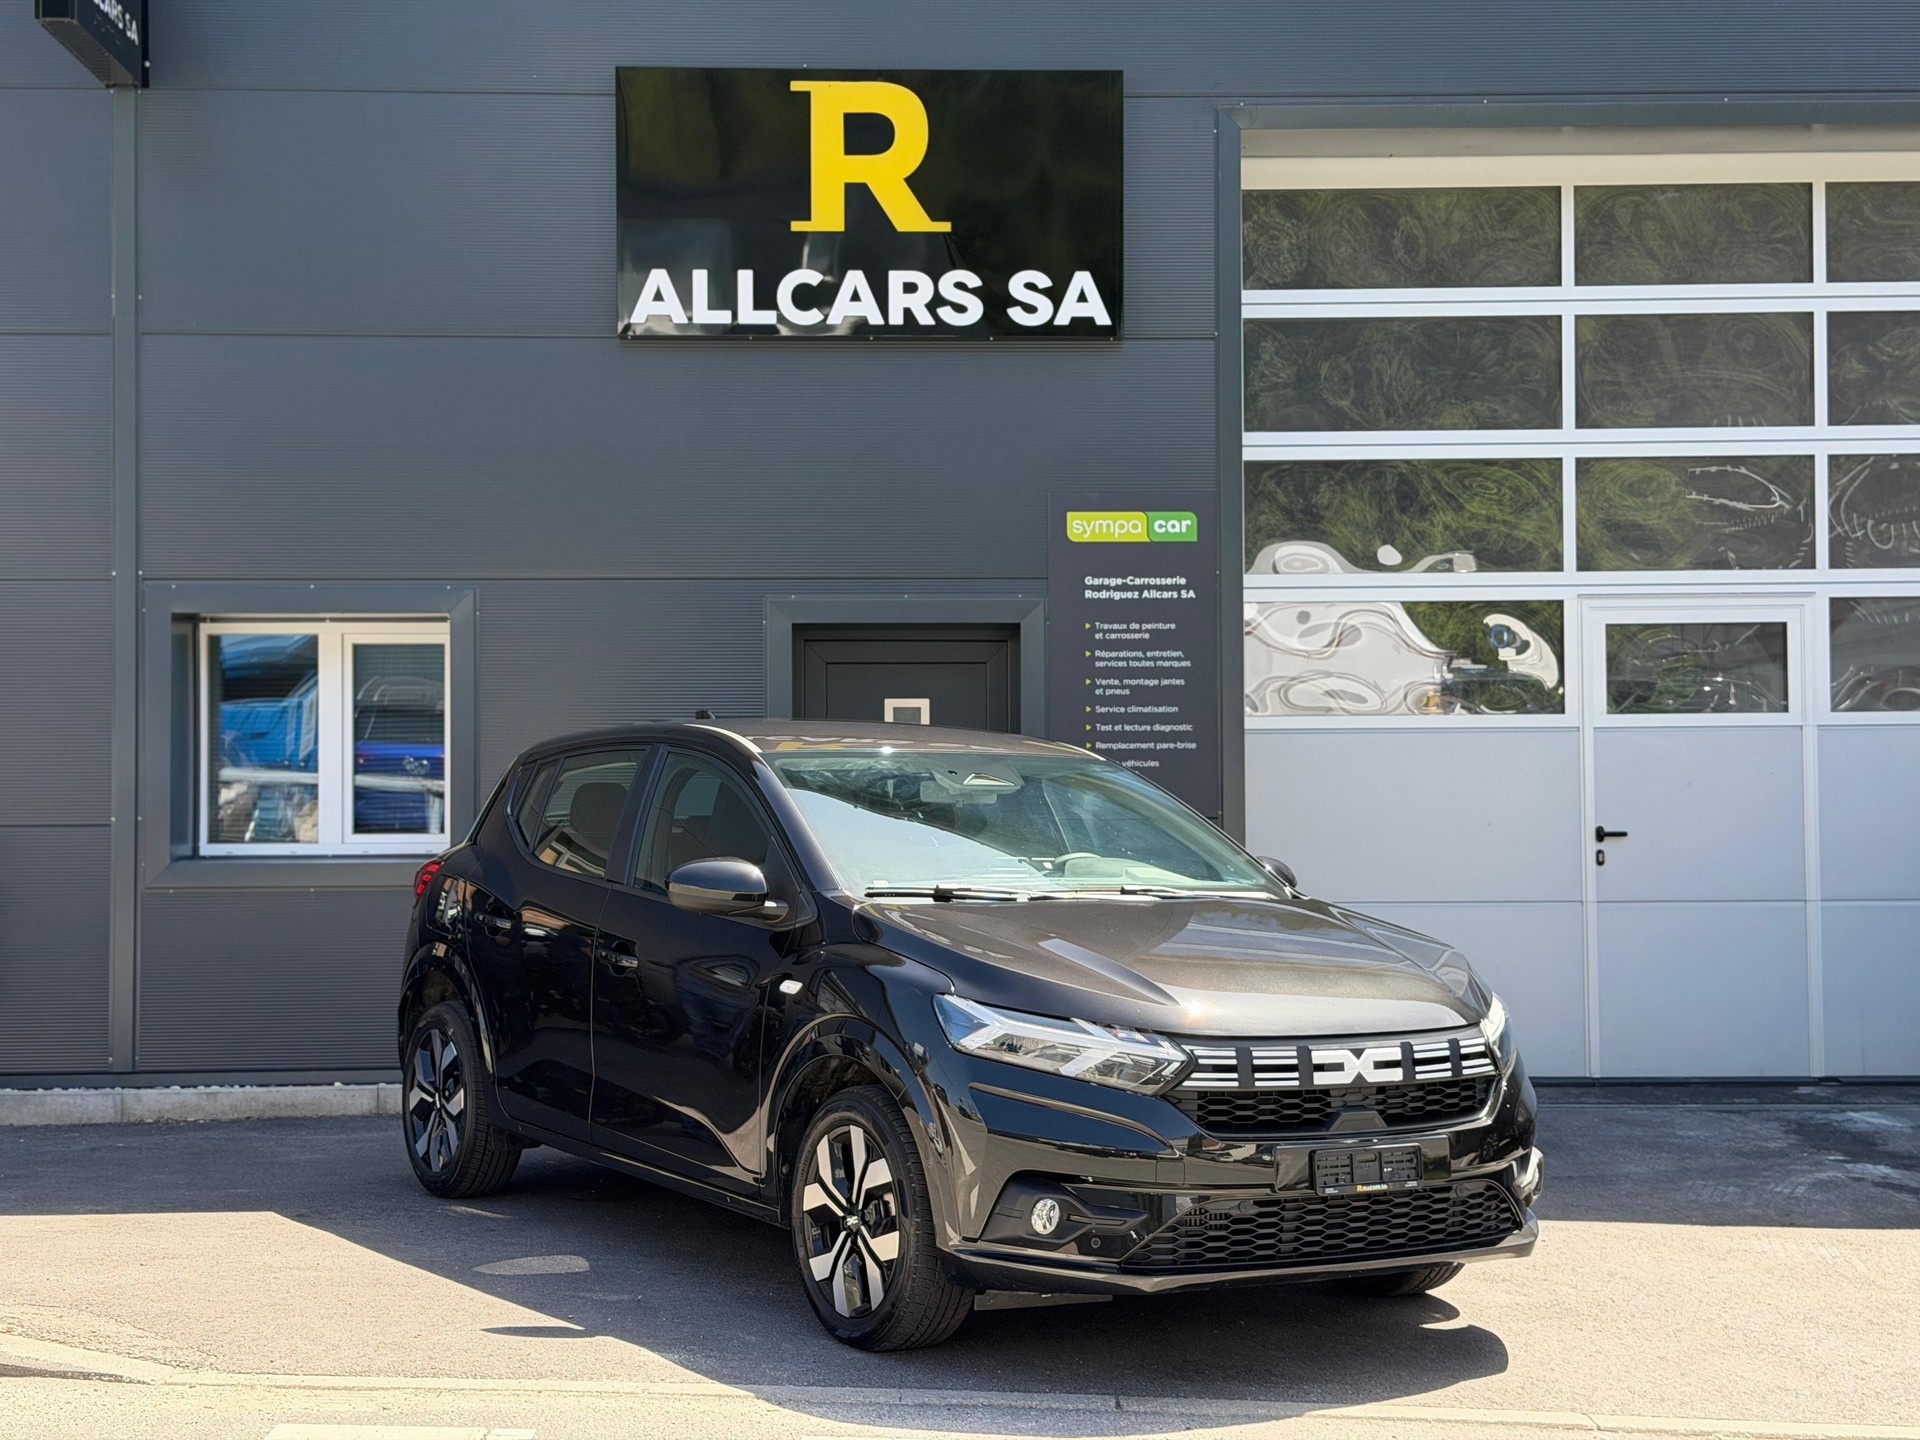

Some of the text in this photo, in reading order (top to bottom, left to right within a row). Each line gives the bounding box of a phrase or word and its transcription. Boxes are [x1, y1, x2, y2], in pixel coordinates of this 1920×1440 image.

[125, 12, 139, 46] SA
[789, 80, 952, 233] R
[630, 268, 1113, 327] ALLCARS SA
[1072, 519, 1192, 538] sympa car
[1084, 576, 1187, 587] Garage-Carrosserie
[1084, 589, 1196, 600] Rodriguez Allcars SA
[1095, 622, 1176, 631] Travaux de peinture
[1095, 632, 1150, 640] et carrosserie
[1095, 649, 1184, 659] Réparations, entretien,
[1095, 660, 1191, 669] services toutes marques
[1095, 678, 1185, 687] Vente, montage jantes
[1095, 688, 1130, 696] et pneus
[1095, 705, 1178, 713] Service climatisation
[1095, 723, 1193, 733] Test et lecture diagnostic
[1095, 741, 1197, 751] Remplacement pare-brise
[1121, 759, 1160, 768] véhicules
